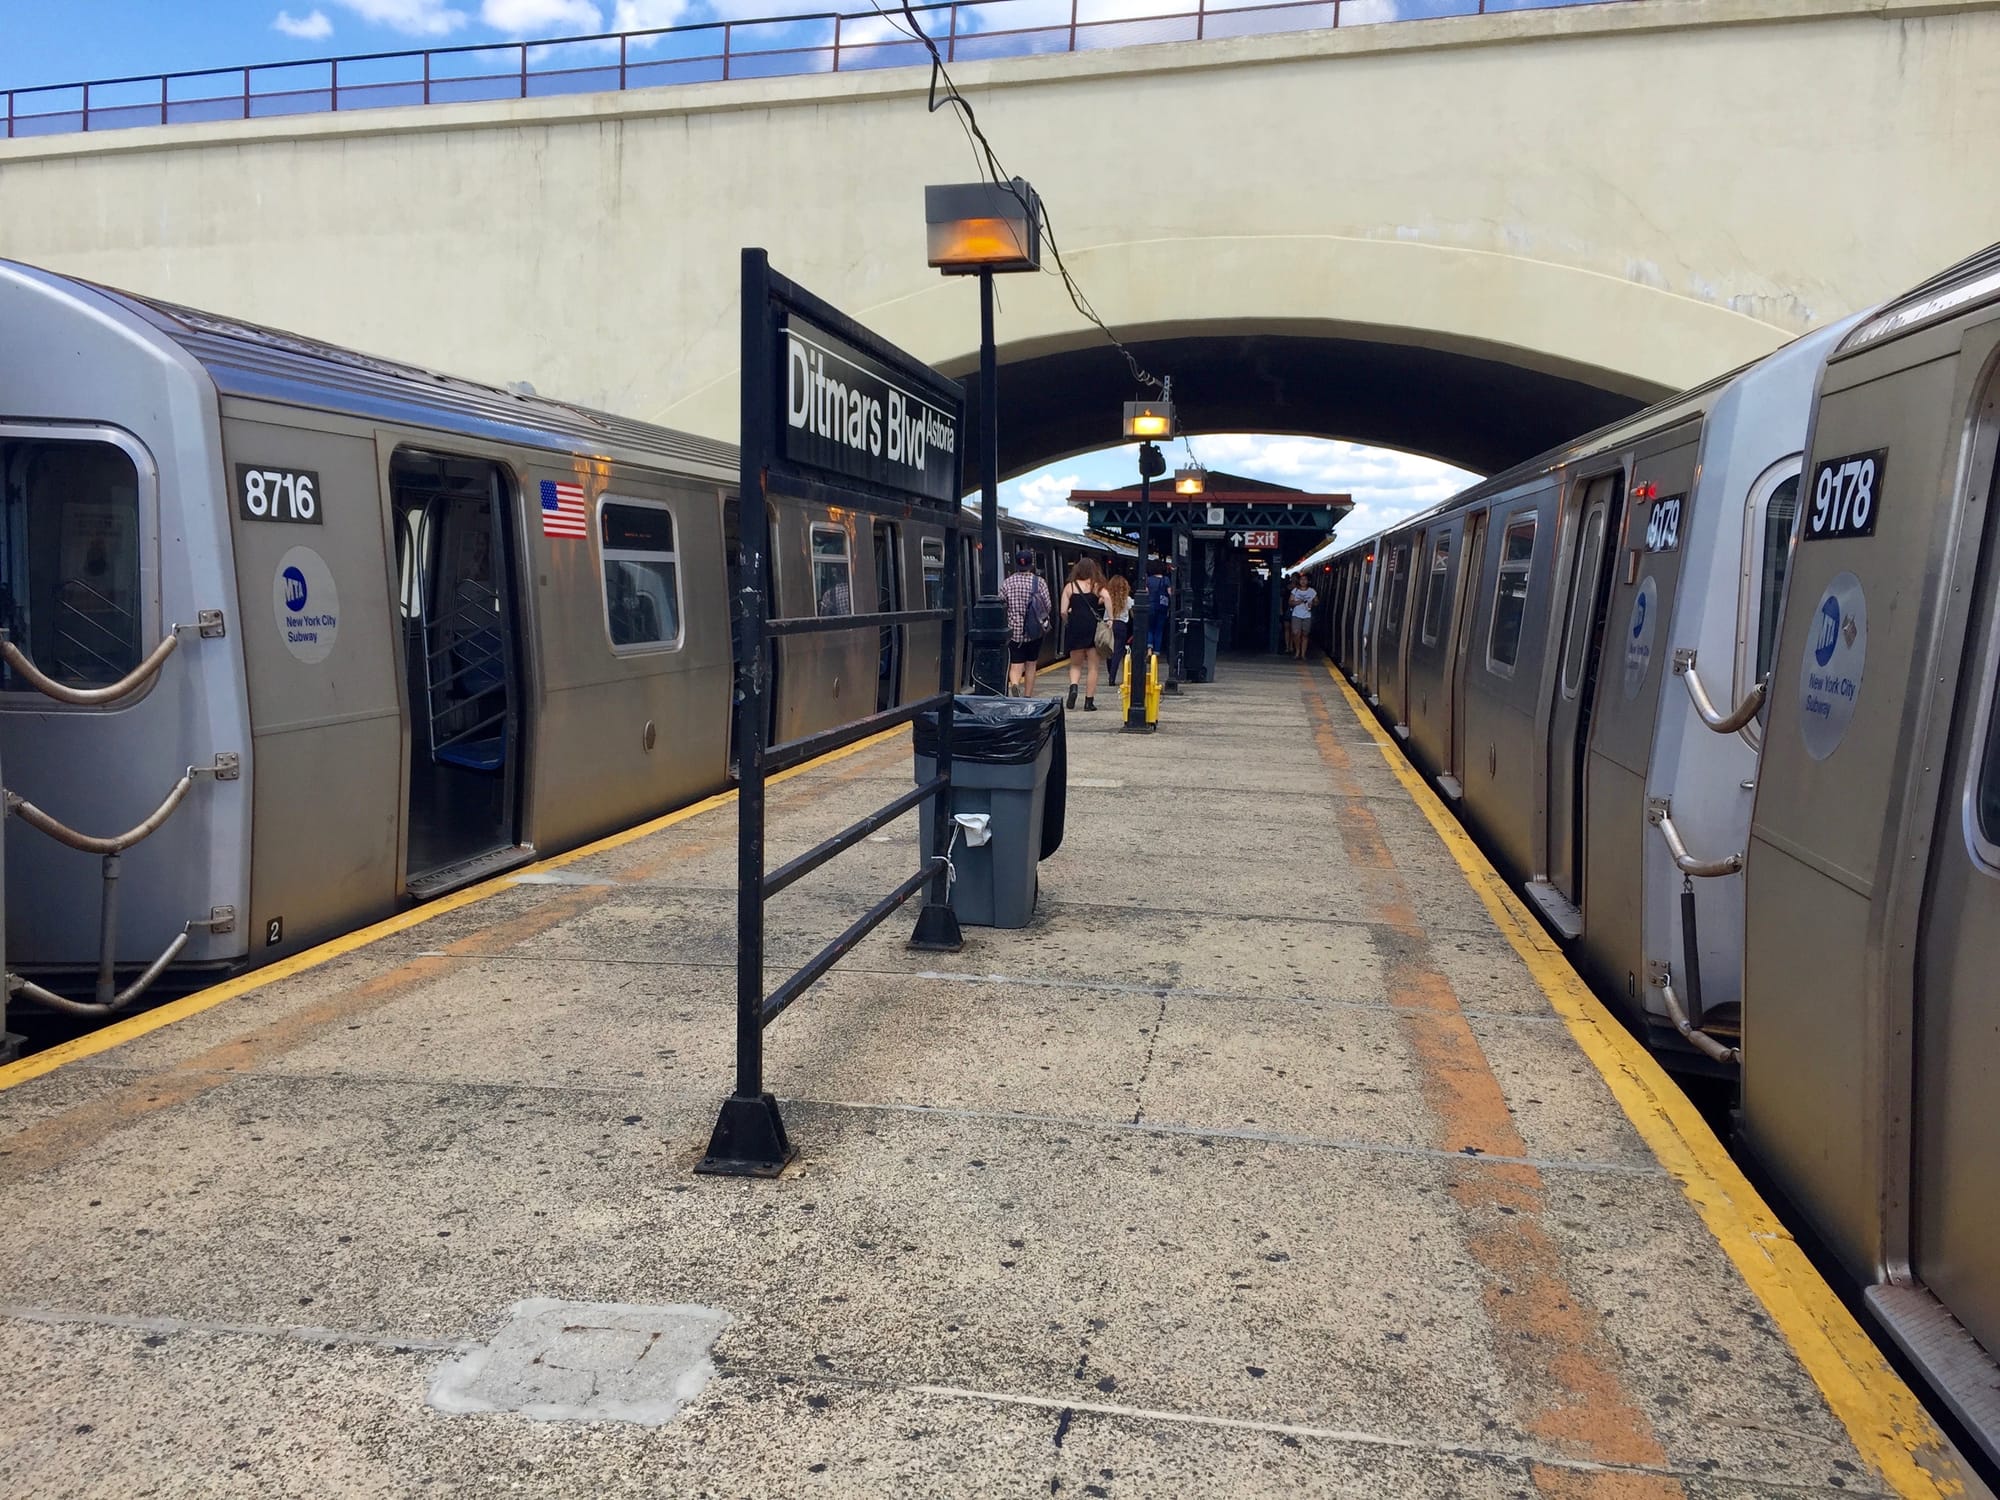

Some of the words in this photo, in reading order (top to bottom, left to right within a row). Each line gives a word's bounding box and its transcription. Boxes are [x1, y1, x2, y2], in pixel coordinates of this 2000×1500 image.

[788, 338, 882, 457] Ditmars
[887, 389, 927, 471] Blvd
[926, 410, 954, 453] Astoria
[245, 470, 315, 519] 8716
[1813, 458, 1875, 532] 9178
[1648, 499, 1680, 548] 9179
[1244, 531, 1276, 546] Exit
[283, 574, 306, 604] MTA
[286, 616, 303, 627] New
[303, 616, 321, 627] York
[322, 614, 336, 628] City
[288, 631, 317, 644] Subway
[1809, 673, 1823, 690] New
[1825, 674, 1840, 694] York
[1841, 678, 1856, 701] City
[1806, 694, 1831, 719] Subway
[270, 921, 279, 941] 2
